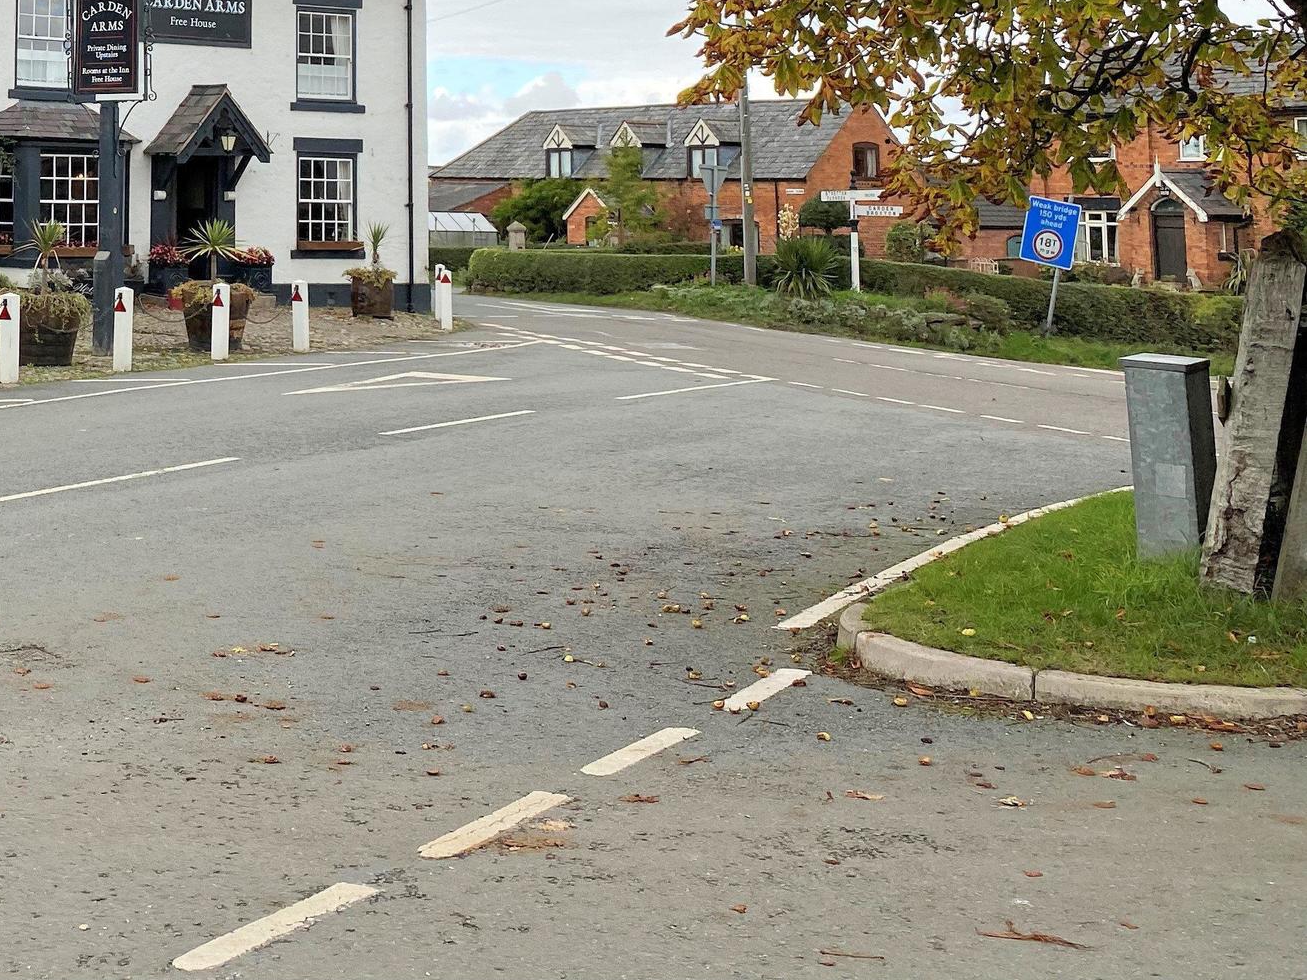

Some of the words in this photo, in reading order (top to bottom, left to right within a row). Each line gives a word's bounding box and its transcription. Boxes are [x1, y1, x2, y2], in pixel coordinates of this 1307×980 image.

[82, 0, 133, 21] CARDEN
[90, 20, 124, 32] ARMS
[170, 16, 188, 26] Free
[190, 18, 216, 28] House
[106, 44, 127, 52] Dining
[96, 52, 118, 60] Upstairs
[1032, 200, 1052, 209] Weak
[1054, 205, 1078, 216] bridge
[1054, 213, 1067, 221] yds
[1040, 219, 1063, 228] ahead
